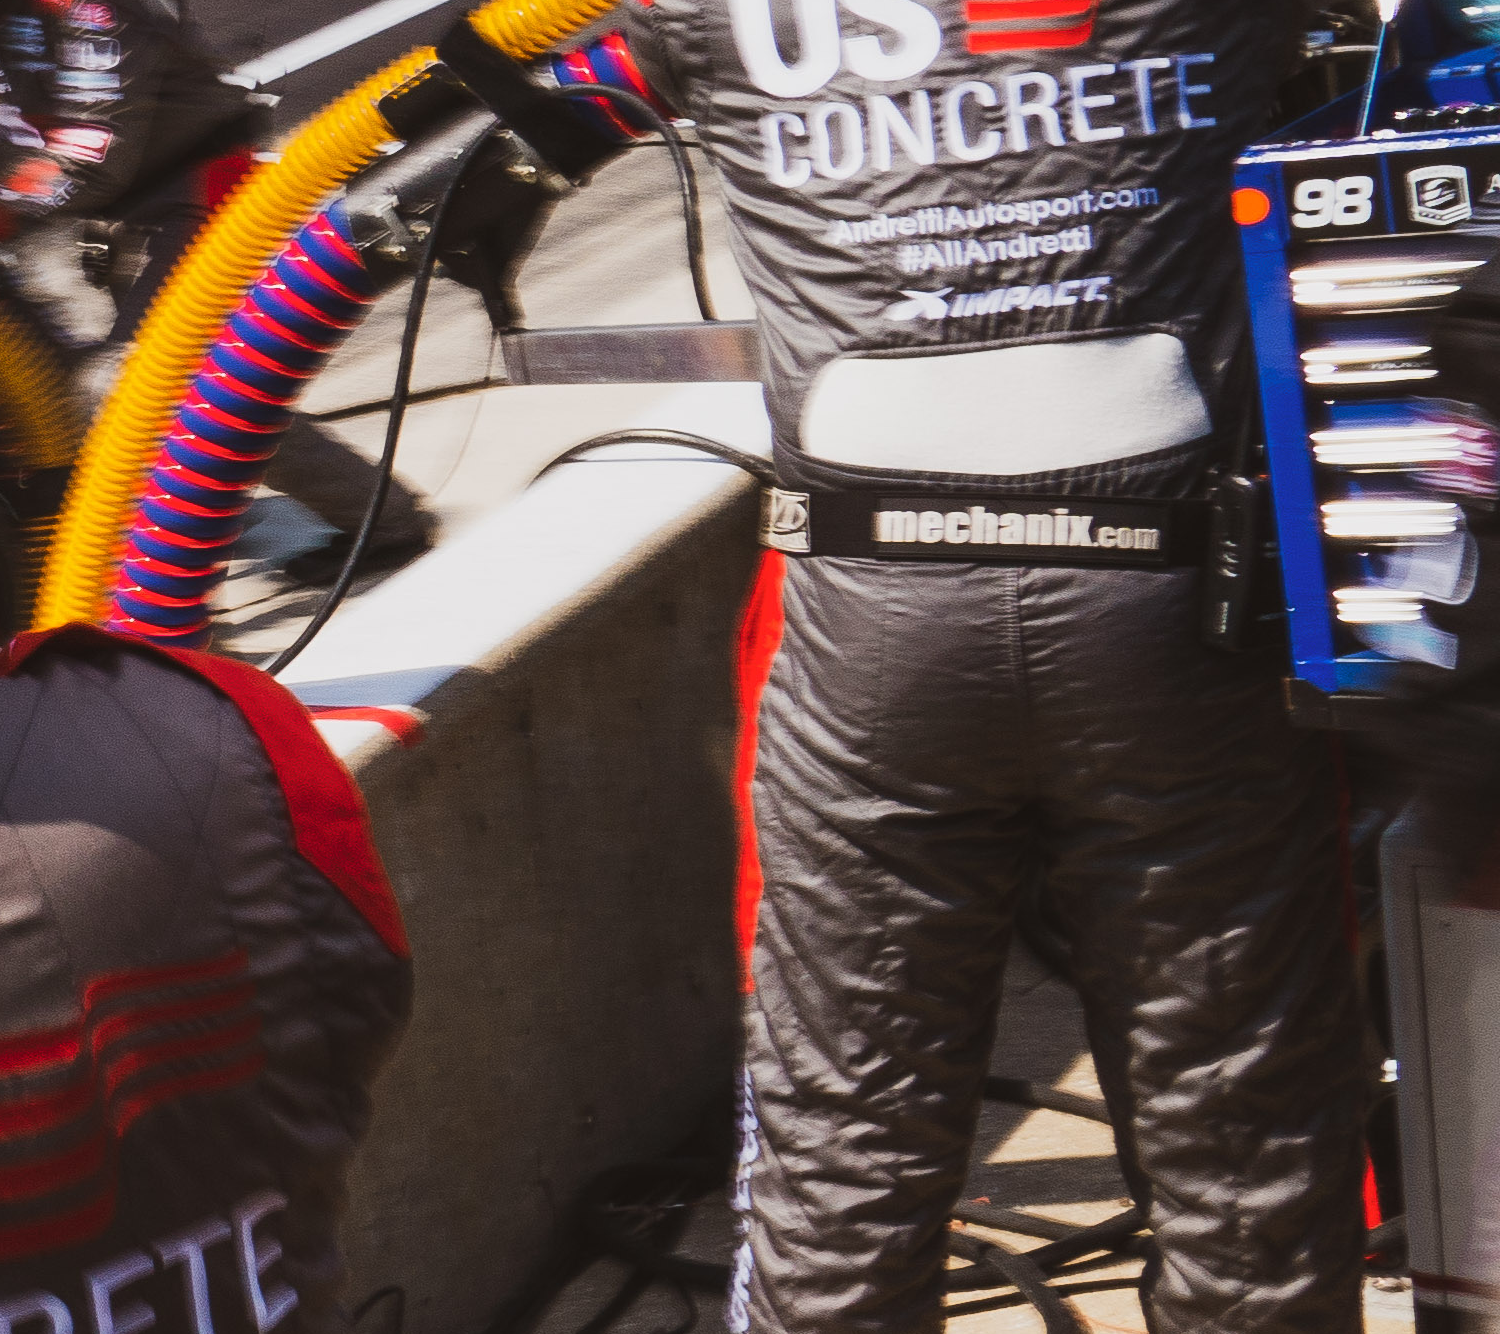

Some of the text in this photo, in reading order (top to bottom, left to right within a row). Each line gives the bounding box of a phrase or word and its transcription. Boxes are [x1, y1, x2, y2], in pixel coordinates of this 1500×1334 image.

[762, 53, 1216, 188] CONCRETE
[830, 186, 1158, 245] AndrettiAutosport.com
[1291, 175, 1374, 229] 98
[898, 225, 1093, 273] #AllAndretti
[948, 276, 1112, 318] IMPACT
[872, 505, 1161, 551] mechanix.com
